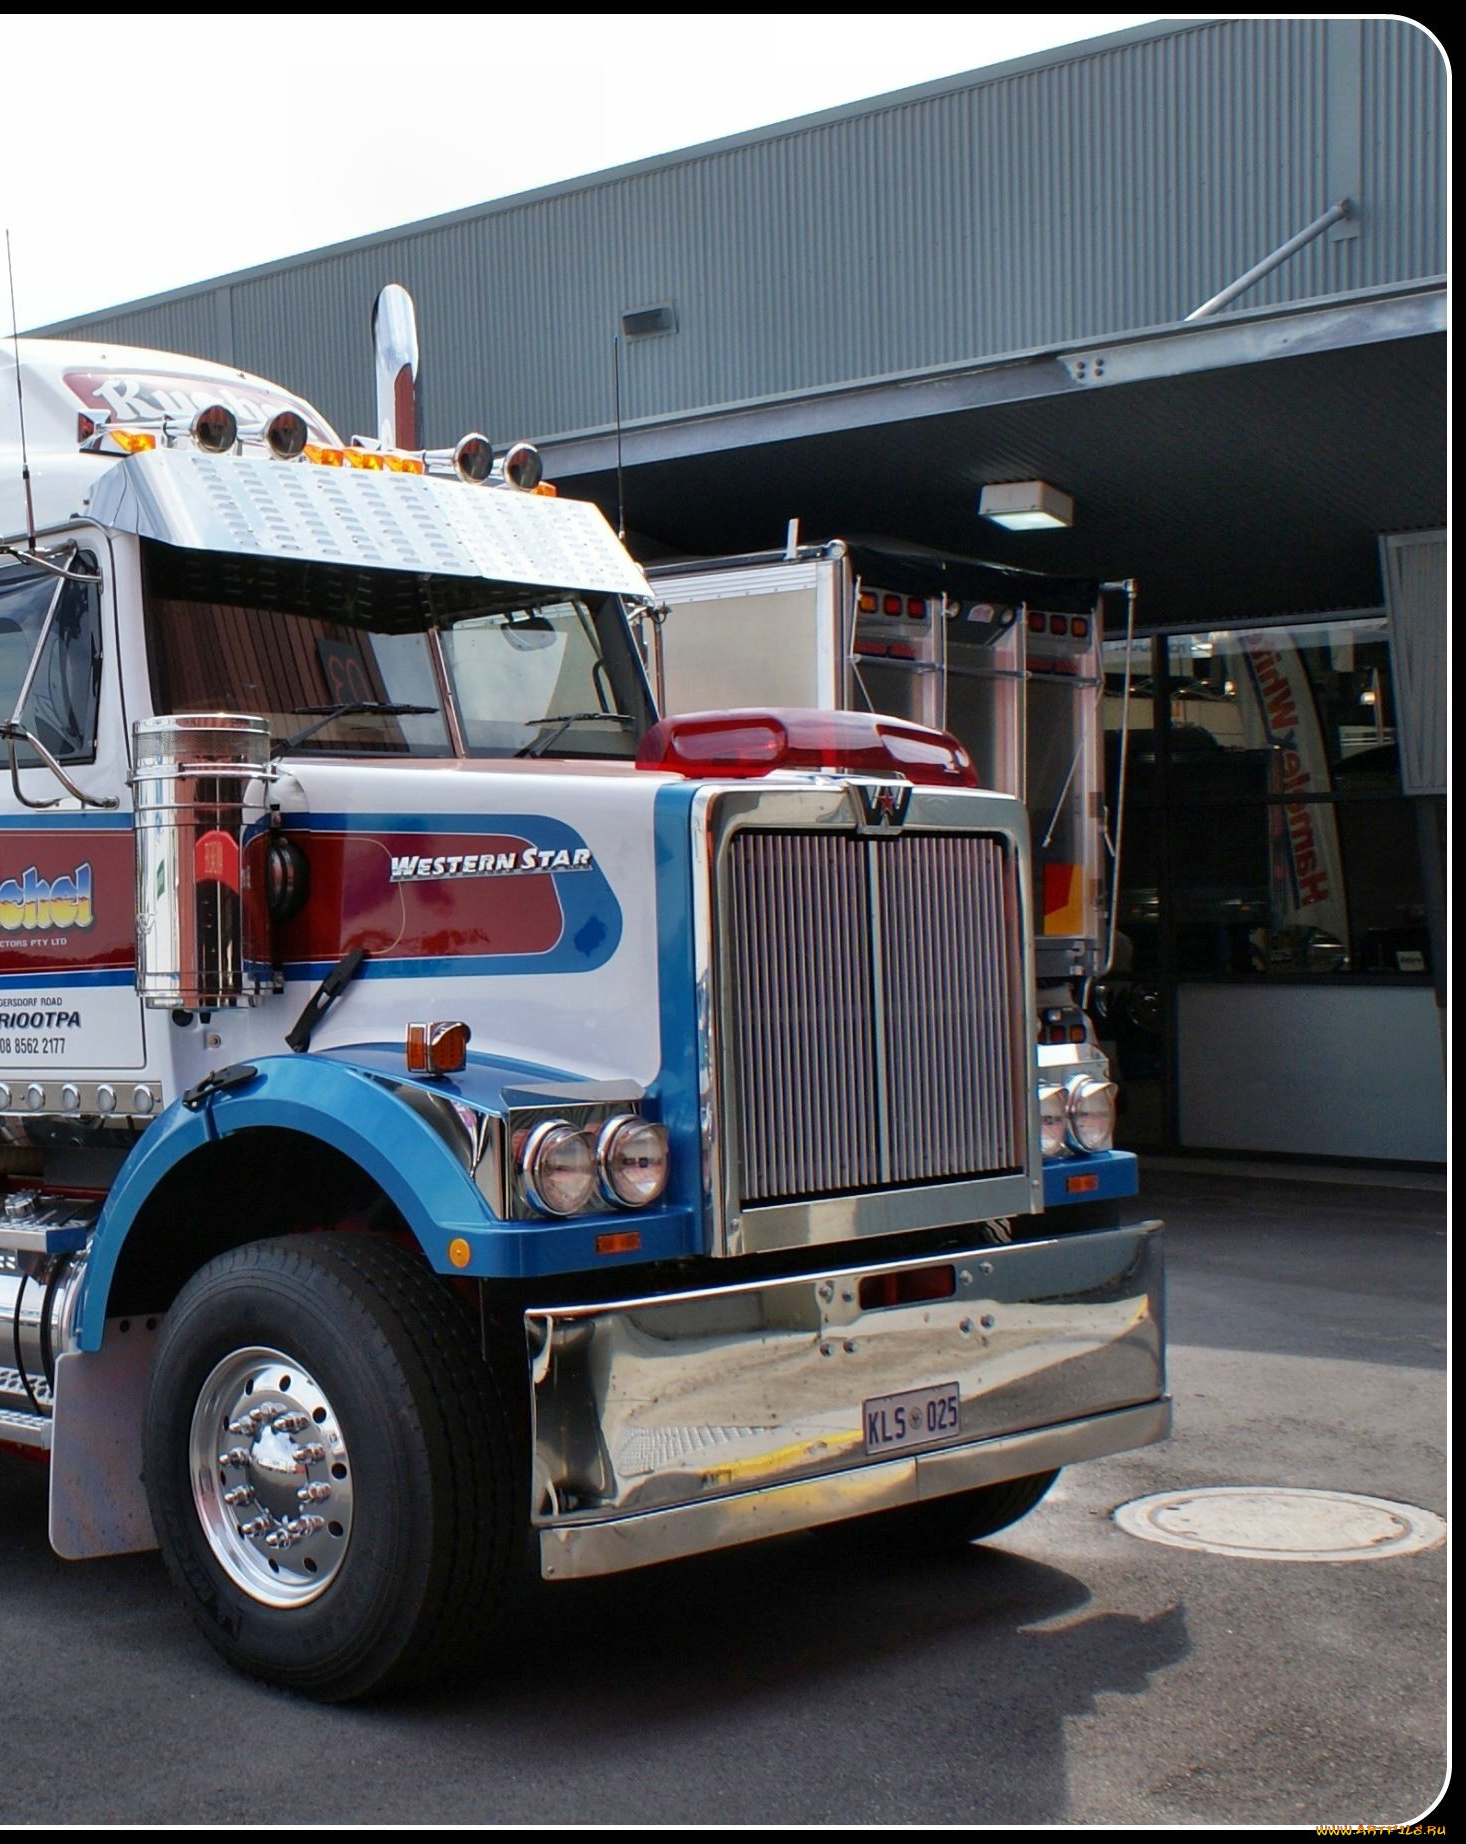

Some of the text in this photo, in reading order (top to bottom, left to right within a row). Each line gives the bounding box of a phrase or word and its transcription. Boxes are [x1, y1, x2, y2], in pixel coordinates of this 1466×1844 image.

[391, 848, 591, 876] WESTERN STAR
[30, 939, 49, 947] PTY
[51, 937, 68, 946] LTD
[40, 996, 63, 1007] ROAD
[0, 1037, 12, 1054] 08
[14, 1037, 39, 1054] 8562
[42, 1037, 66, 1054] 2177
[868, 1396, 958, 1444] KLS 025
